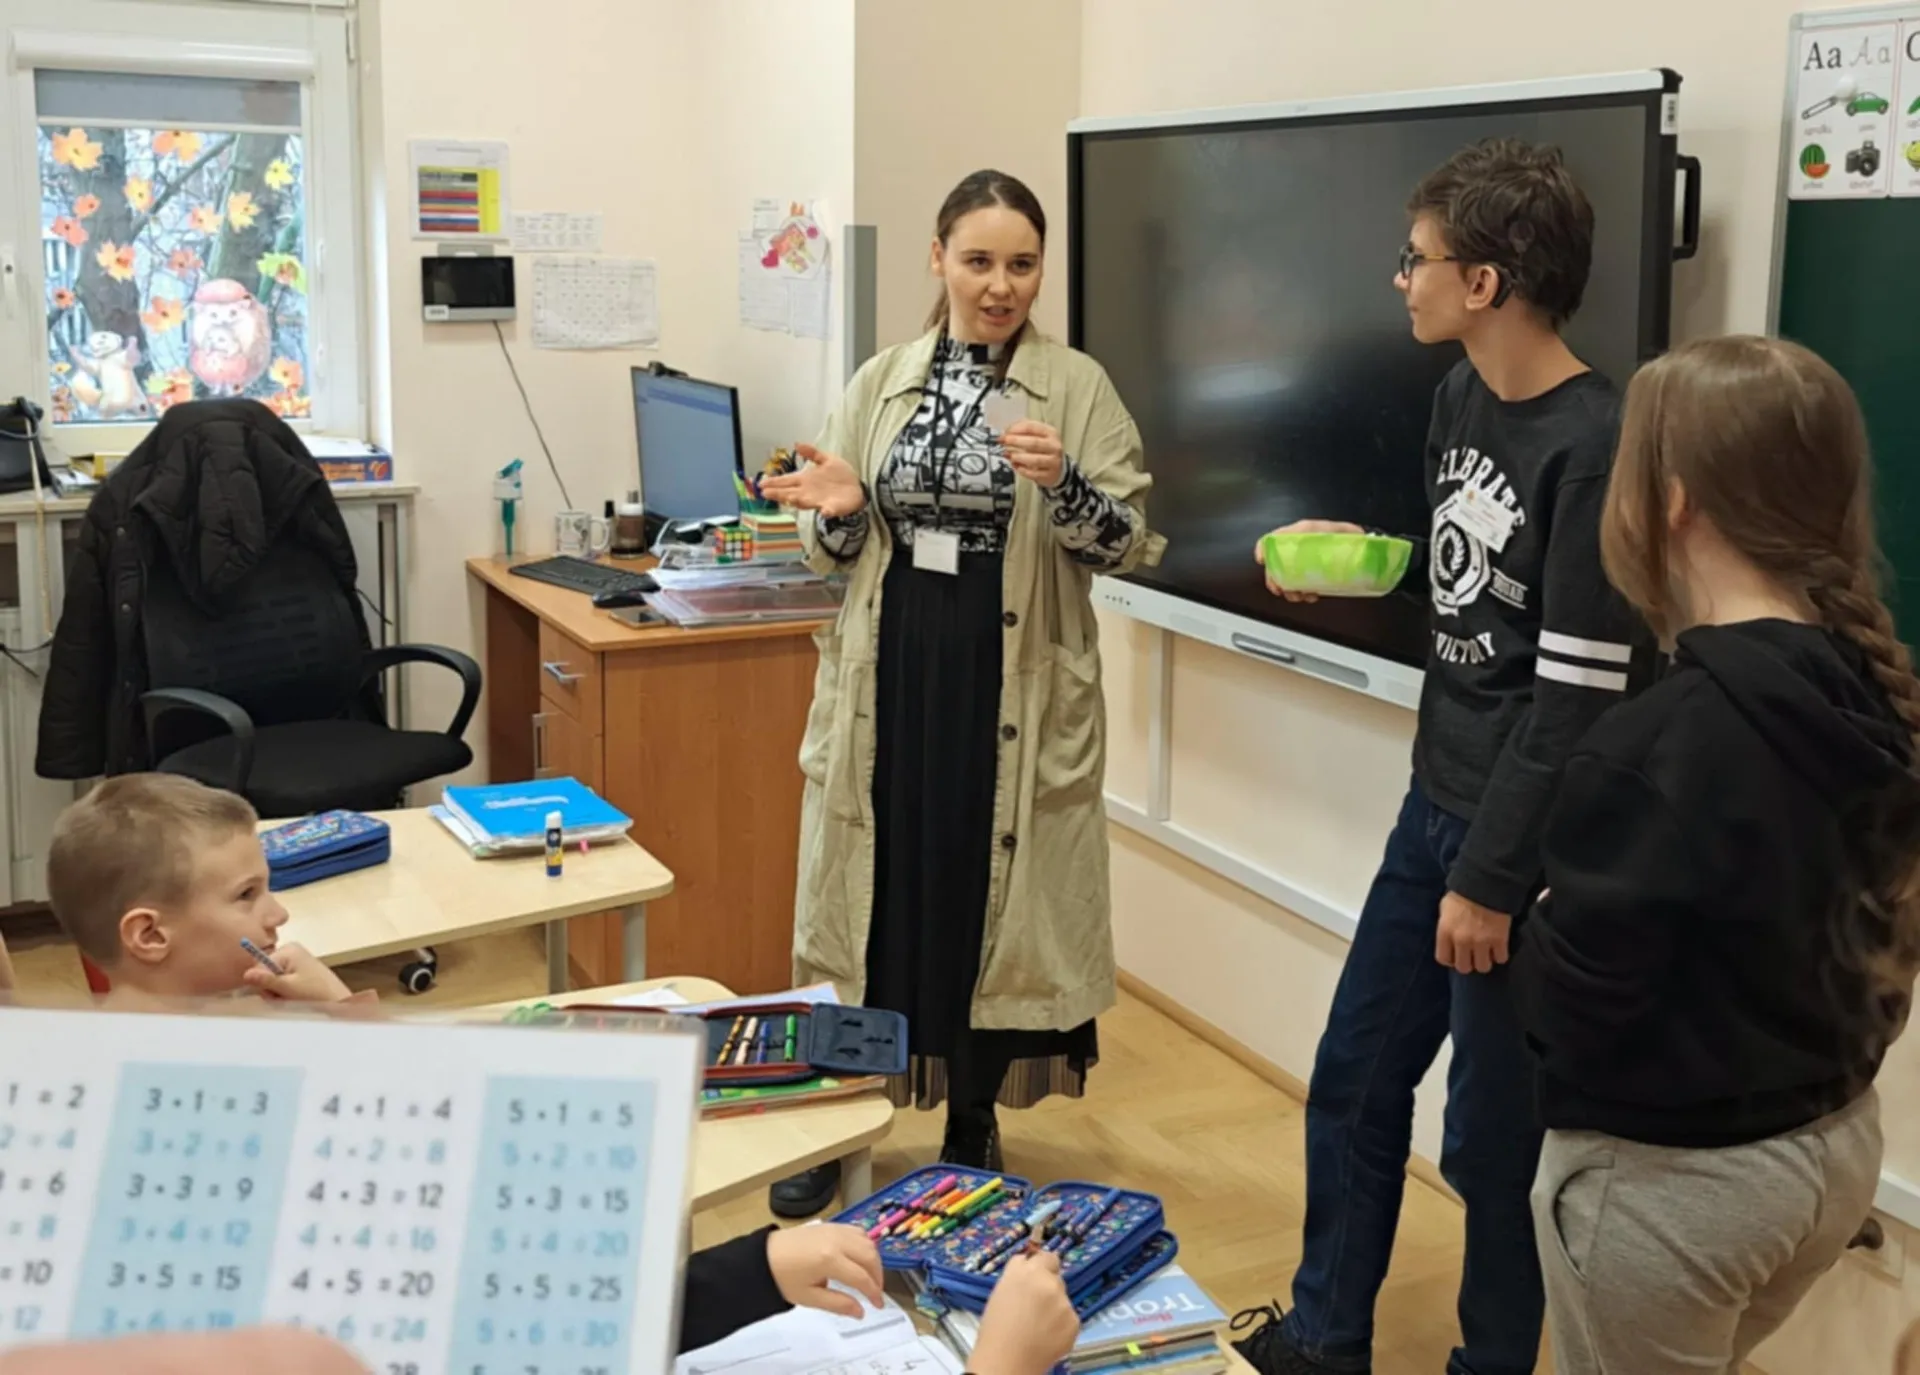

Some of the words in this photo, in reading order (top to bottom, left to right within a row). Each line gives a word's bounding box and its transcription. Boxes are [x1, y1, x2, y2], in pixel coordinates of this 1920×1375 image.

[1803, 41, 1842, 70] Aa
[8, 1082, 19, 1107] 1
[66, 1083, 86, 1110] 2
[144, 1087, 162, 1113] 3
[194, 1089, 204, 1113] 1
[251, 1091, 268, 1115] 3
[321, 1094, 341, 1118] 4
[376, 1095, 387, 1119] 1
[433, 1096, 453, 1121] 4
[509, 1099, 525, 1125] 5
[558, 1101, 568, 1126] 1
[617, 1103, 634, 1128] 5
[46, 1170, 67, 1198] 6
[126, 1173, 146, 1199] 3
[174, 1175, 194, 1201] 3
[236, 1177, 254, 1202] 9
[306, 1180, 326, 1205] 4
[359, 1180, 378, 1207] 3
[418, 1182, 444, 1209] 12
[497, 1184, 512, 1210] 5
[545, 1186, 562, 1212] 3
[604, 1187, 629, 1214] 15
[23, 1259, 53, 1286] 10
[108, 1262, 126, 1288] 3
[156, 1263, 174, 1289] 5
[216, 1265, 241, 1291] 15
[290, 1267, 311, 1293] 4
[344, 1268, 363, 1296] 5
[397, 1271, 434, 1298] 20
[483, 1272, 500, 1299] 5
[534, 1274, 551, 1301] 5
[589, 1276, 621, 1302] 25
